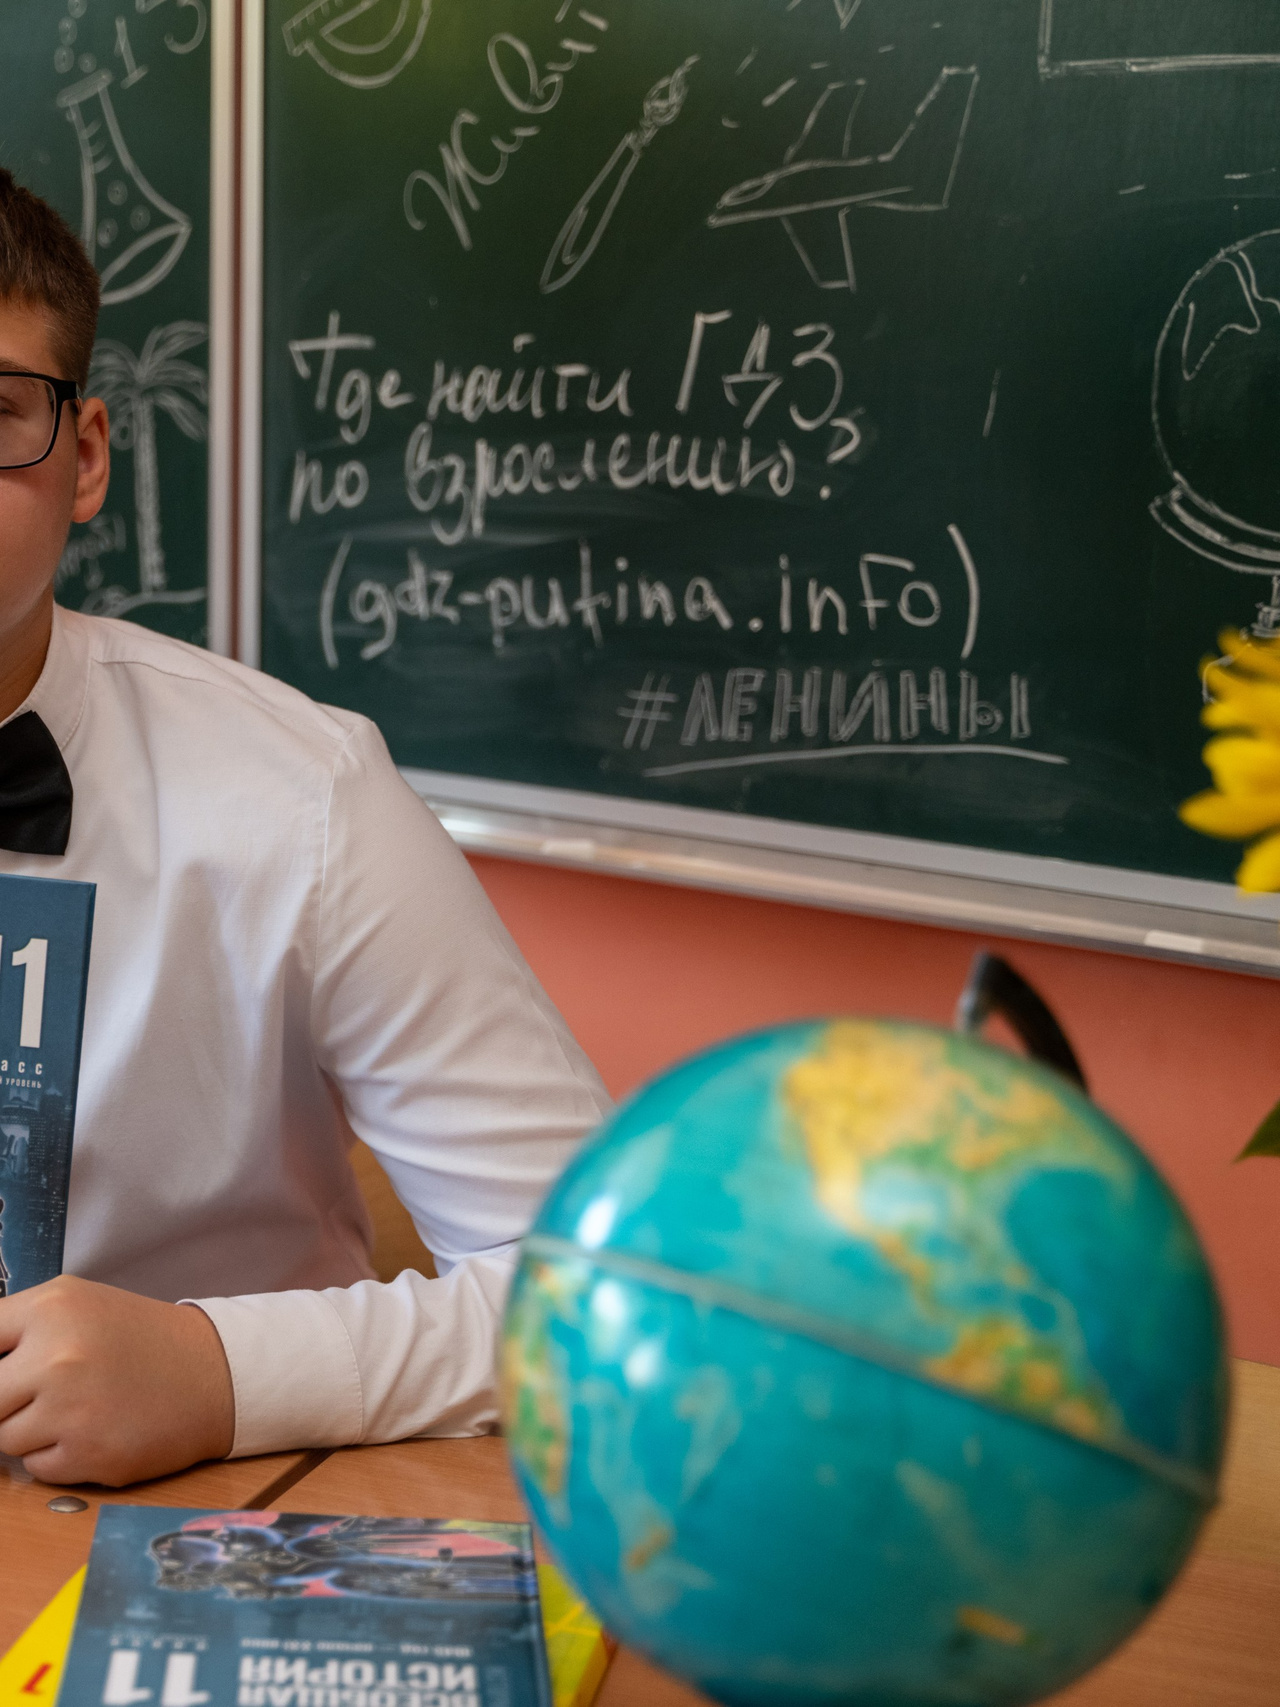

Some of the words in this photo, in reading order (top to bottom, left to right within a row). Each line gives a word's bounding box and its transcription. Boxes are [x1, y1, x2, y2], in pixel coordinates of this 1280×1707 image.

[428, 333, 633, 422] найти
[674, 310, 844, 431] ГДЗ
[289, 450, 369, 523] по
[5, 1076, 43, 1089] УРОВЕНЬ
[102, 1650, 211, 1707] 11
[238, 1654, 478, 1692] ИСТОРИЯ
